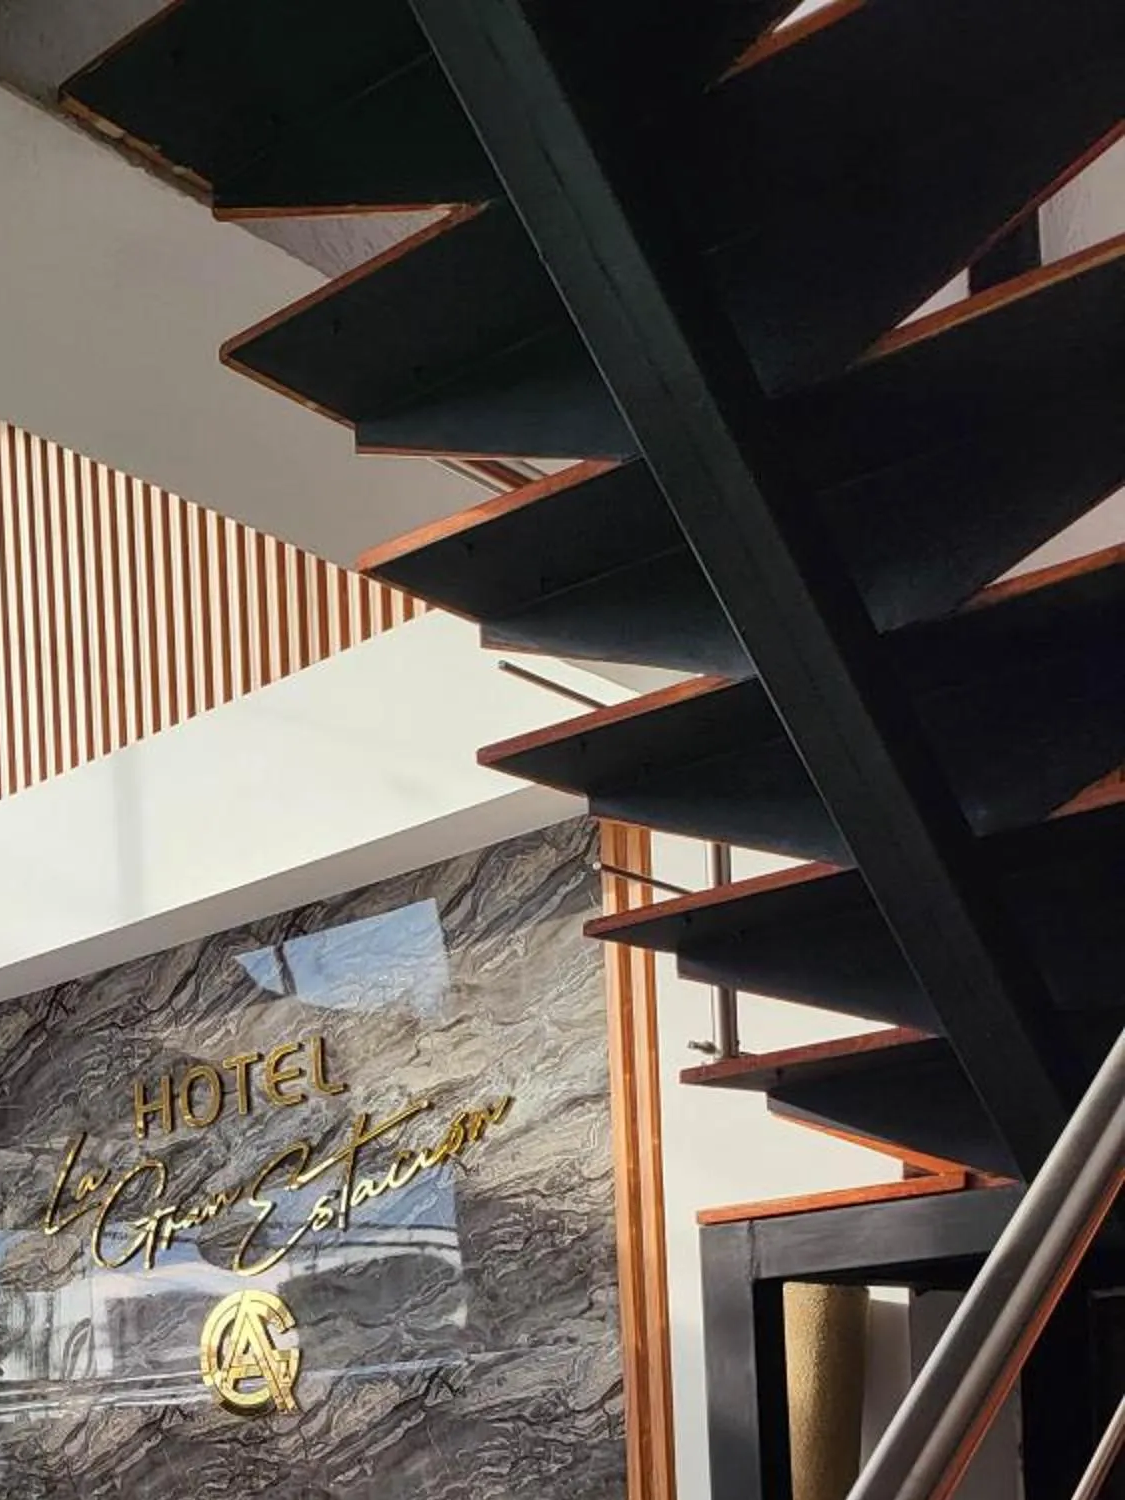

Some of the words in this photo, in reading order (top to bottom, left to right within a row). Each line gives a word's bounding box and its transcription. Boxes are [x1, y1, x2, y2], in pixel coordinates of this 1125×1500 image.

[134, 1035, 348, 1139] HOTEL
[44, 1131, 112, 1235] La
[92, 1157, 244, 1270] Gran
